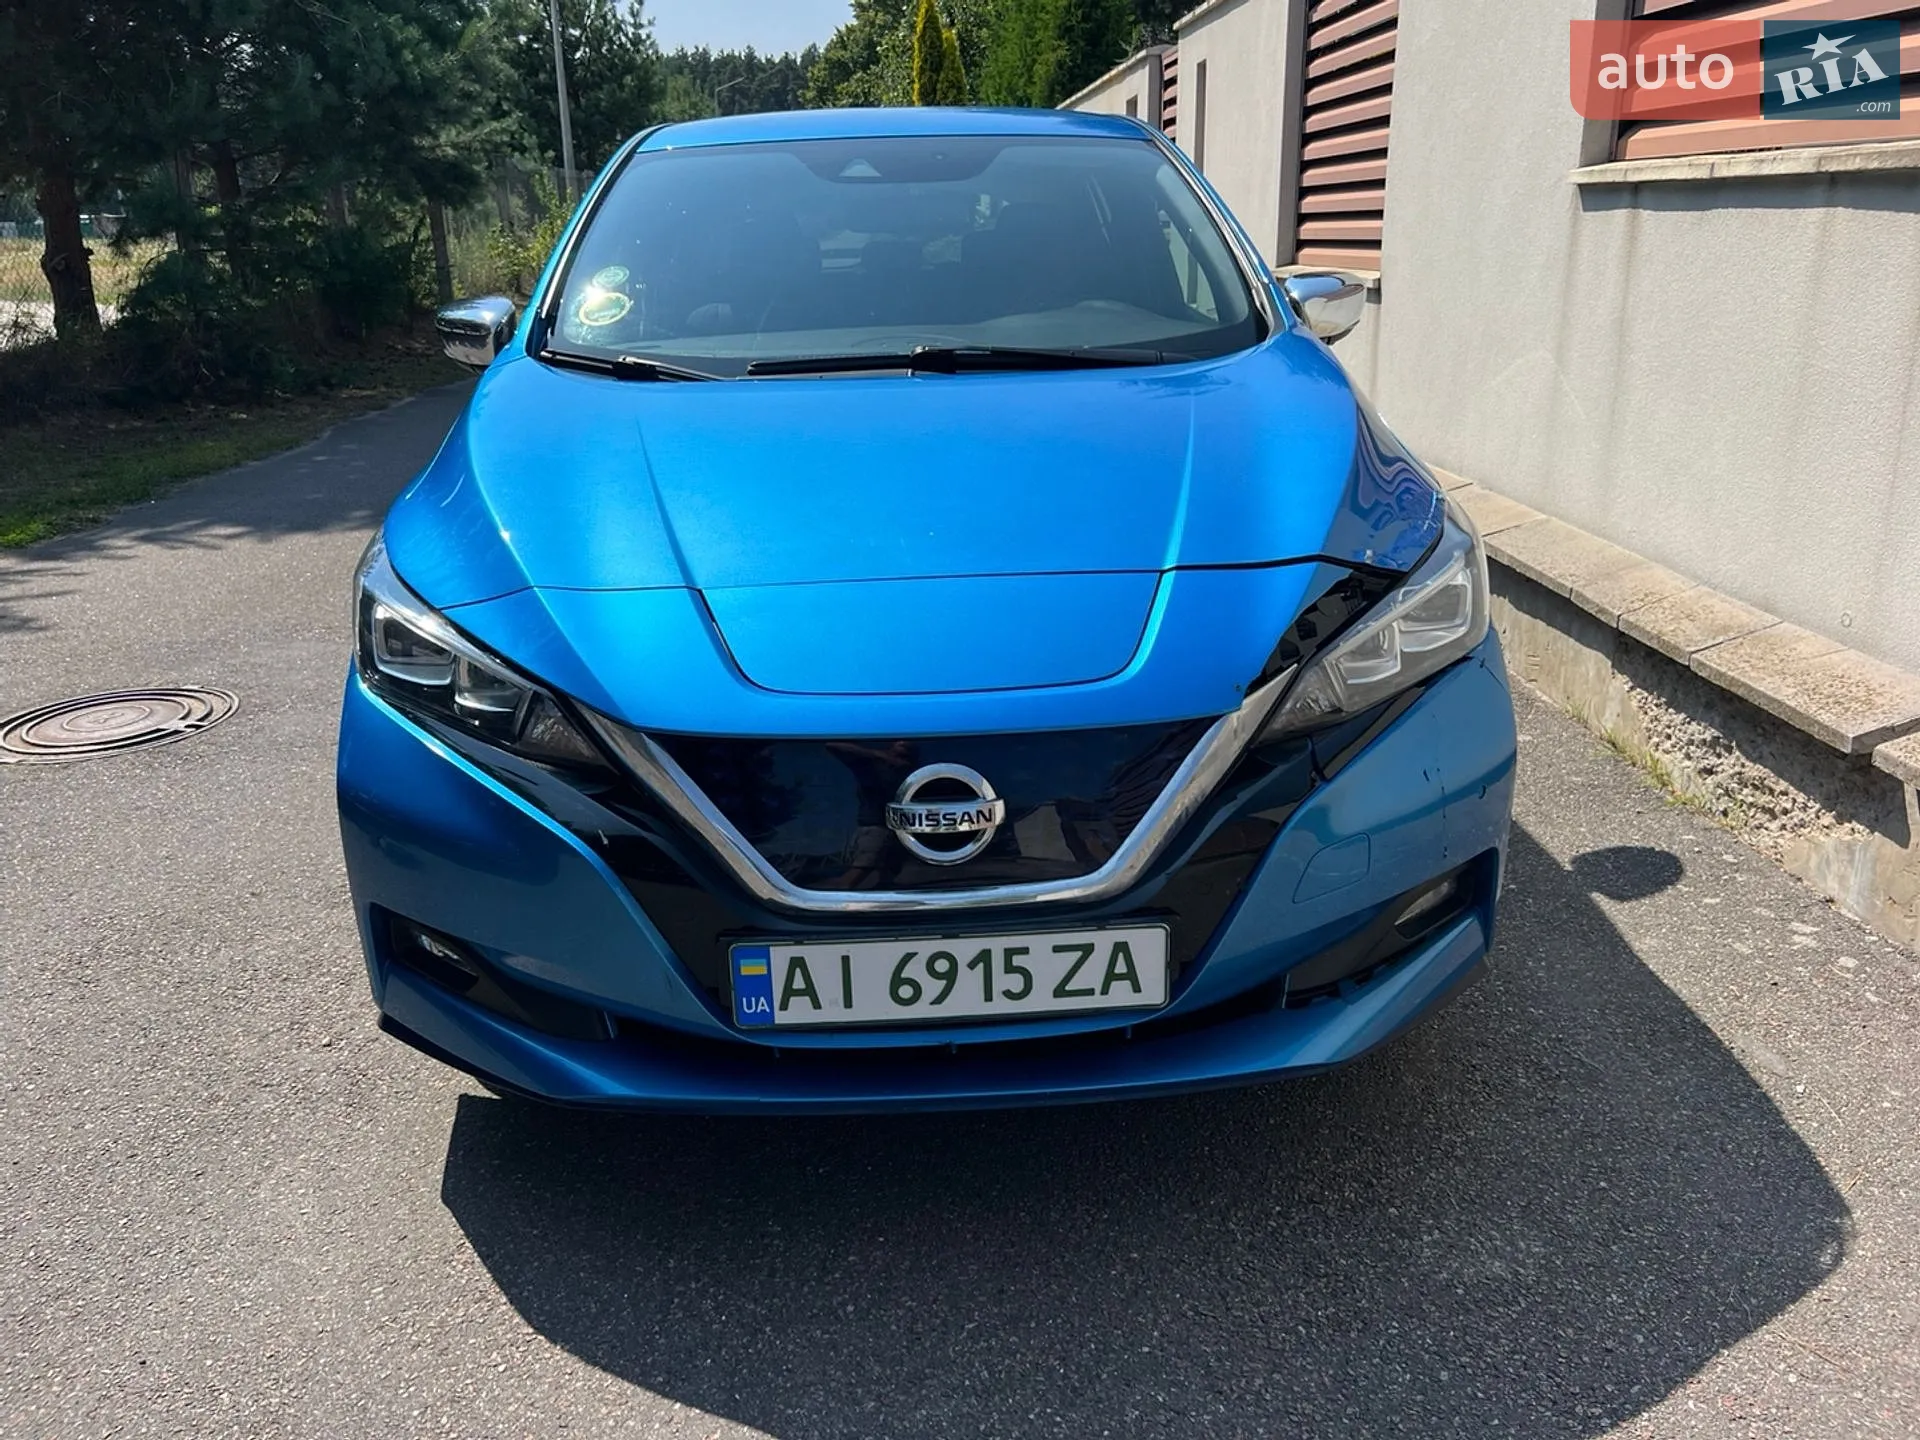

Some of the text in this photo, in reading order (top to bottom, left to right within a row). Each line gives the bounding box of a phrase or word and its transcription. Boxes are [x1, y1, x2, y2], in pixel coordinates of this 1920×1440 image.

[899, 807, 993, 828] NISSAN
[779, 941, 1143, 1011] AI 6915 ZA
[742, 996, 771, 1014] UA
